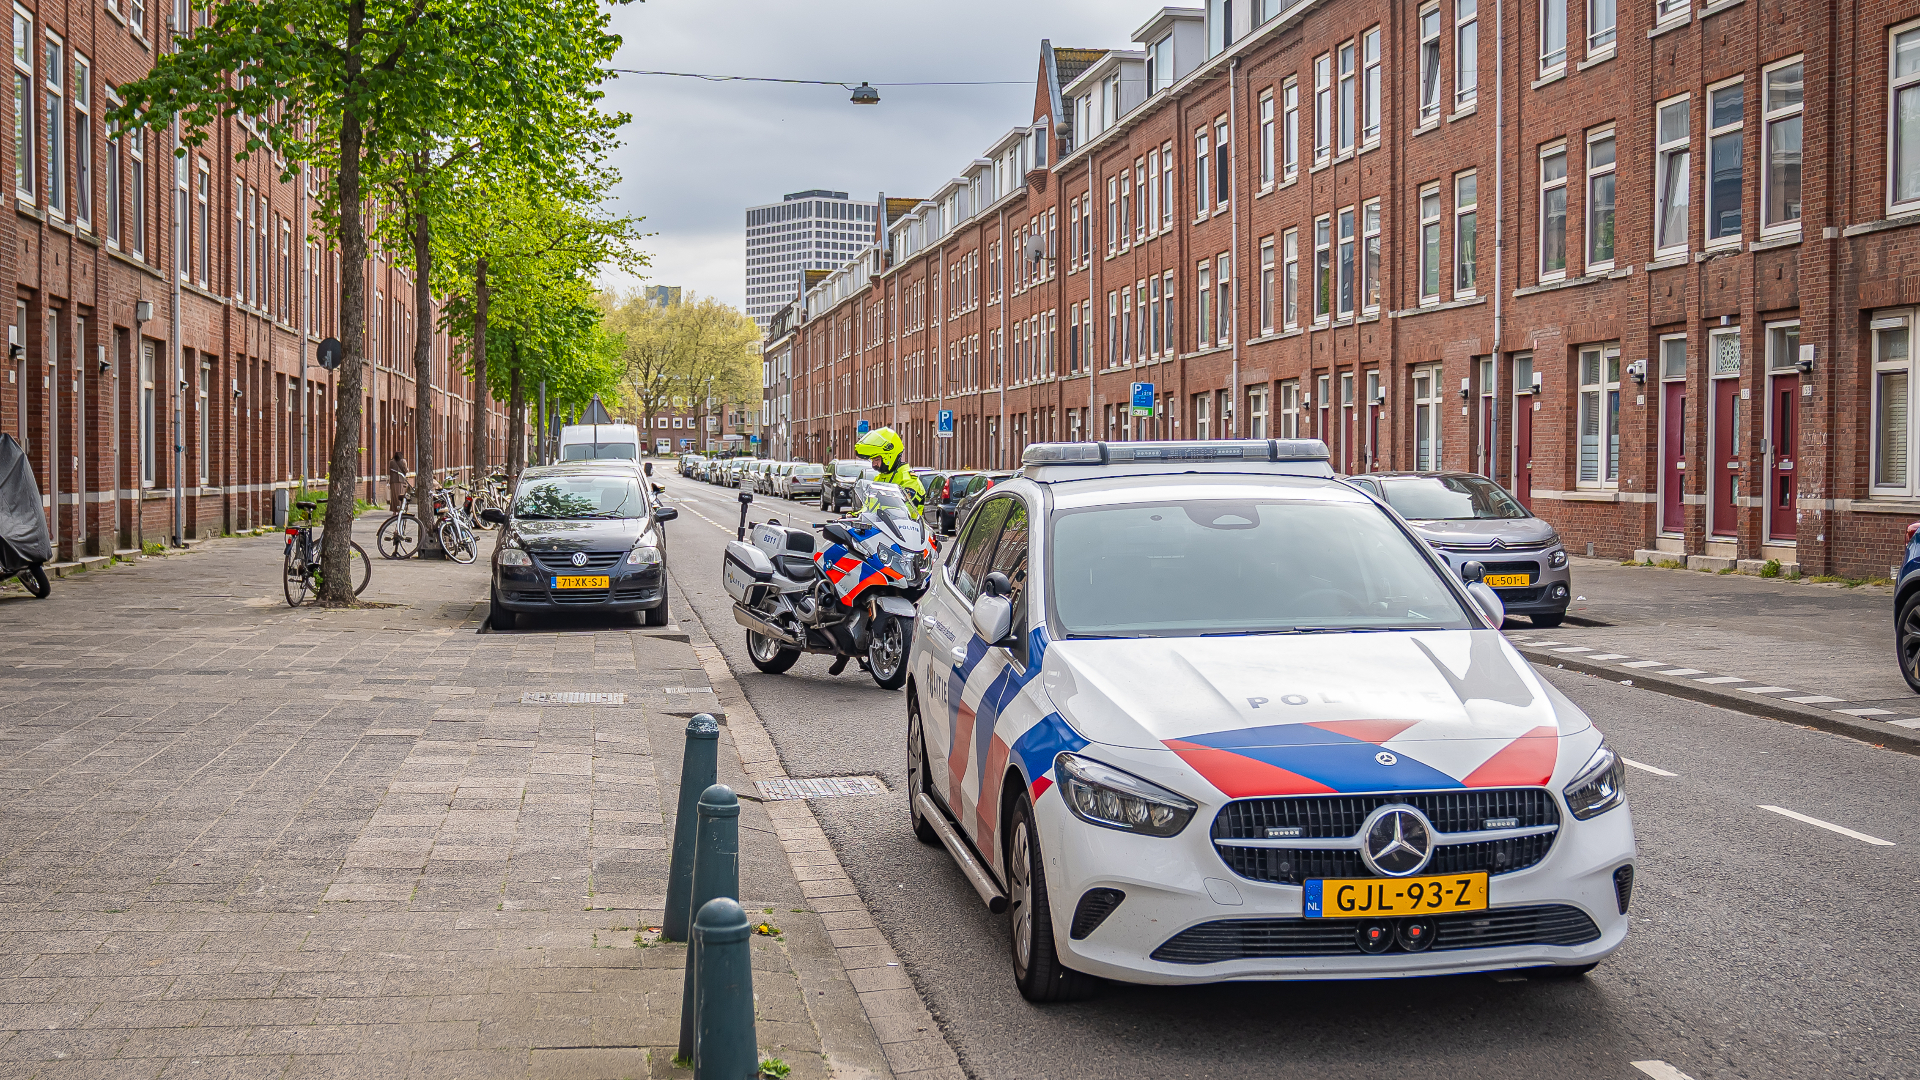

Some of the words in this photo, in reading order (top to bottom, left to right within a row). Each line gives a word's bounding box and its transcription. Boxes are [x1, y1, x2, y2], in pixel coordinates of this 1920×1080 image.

[1134, 384, 1142, 395] P
[941, 411, 949, 422] P
[561, 577, 603, 587] 71-XK-SJ
[1336, 879, 1472, 912] GJL-93-Z
[1307, 902, 1320, 911] NL
